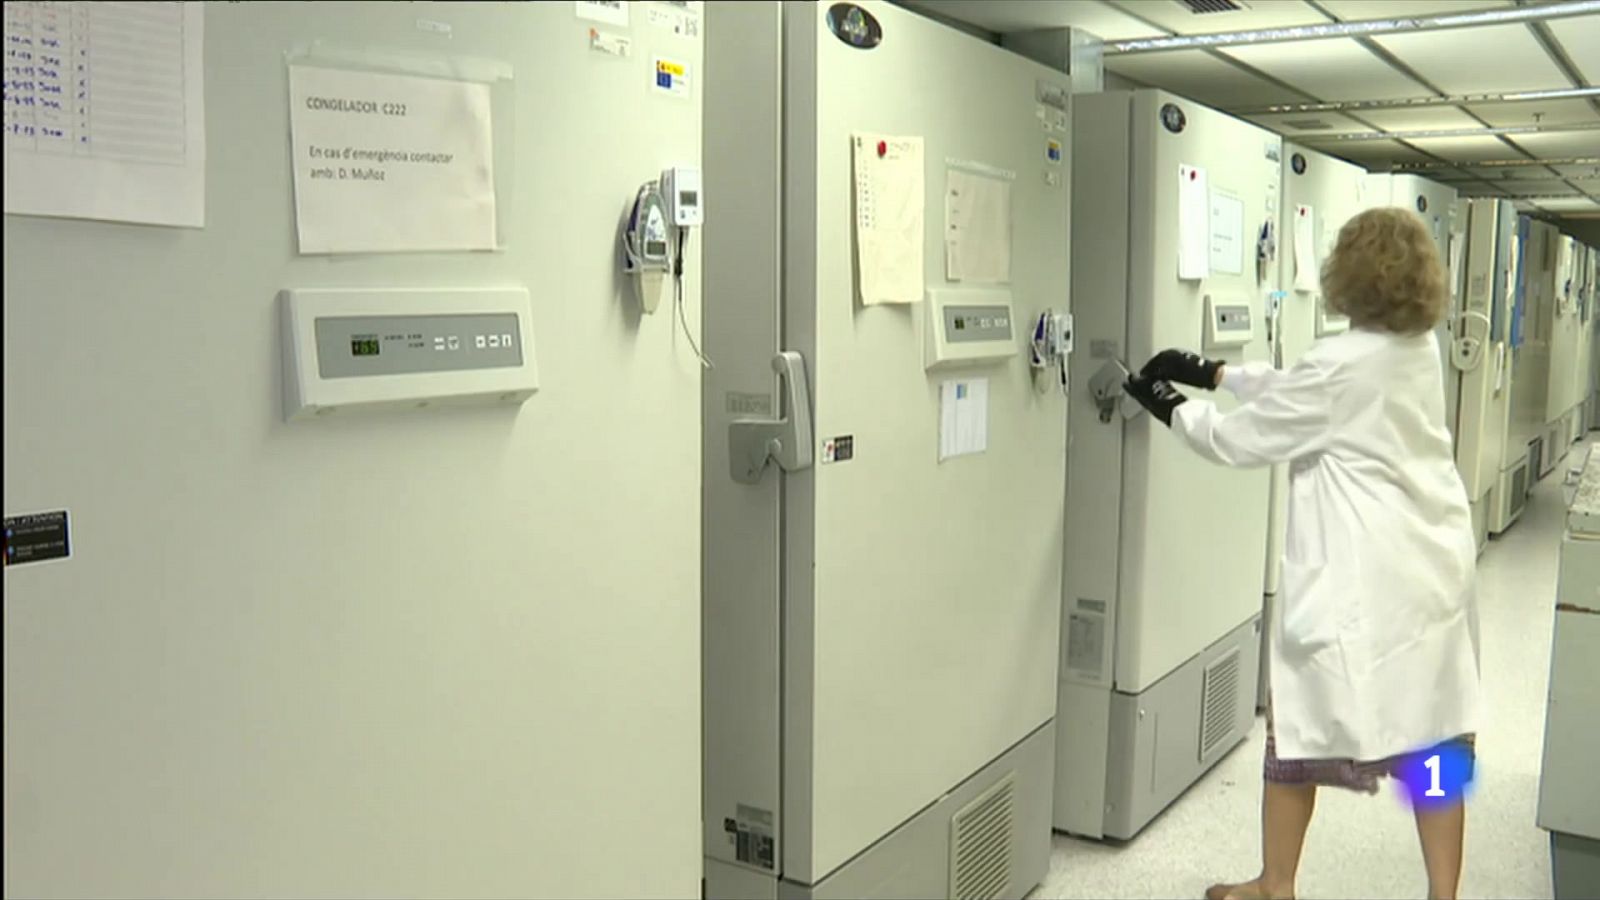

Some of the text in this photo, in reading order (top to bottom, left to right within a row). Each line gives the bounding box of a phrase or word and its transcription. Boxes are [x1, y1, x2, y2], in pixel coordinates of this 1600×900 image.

[306, 96, 407, 116] CONGELADOR C222
[309, 145, 322, 158] En
[324, 148, 341, 159] cas
[410, 151, 454, 164] contactar
[351, 168, 385, 180] Muñoz
